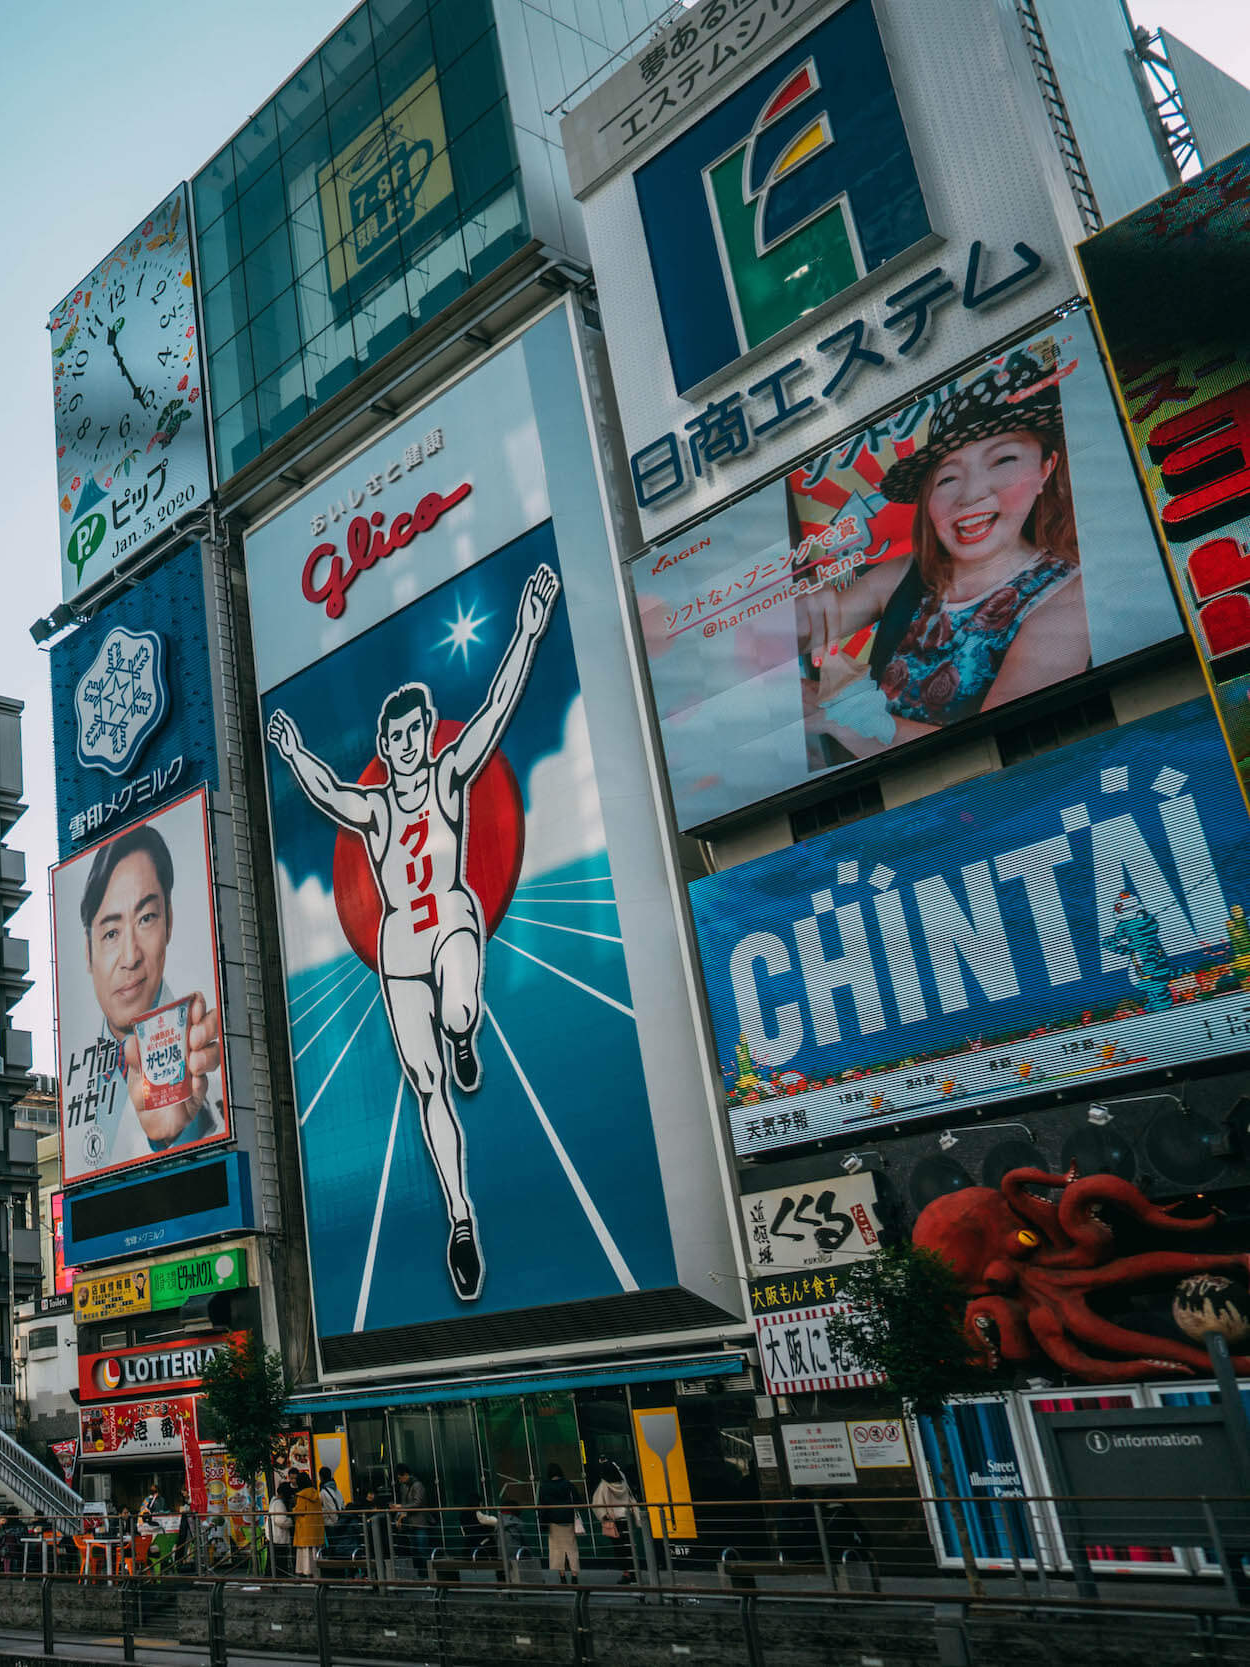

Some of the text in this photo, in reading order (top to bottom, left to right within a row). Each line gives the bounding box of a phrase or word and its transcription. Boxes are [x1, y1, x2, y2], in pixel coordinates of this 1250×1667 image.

[639, 0, 748, 84] 夢ある
[108, 284, 126, 313] 12
[136, 273, 145, 297] 1
[150, 280, 166, 305] 2
[88, 314, 104, 339] 11
[159, 306, 177, 328] 3
[72, 350, 89, 381] 10
[157, 346, 172, 367] 4
[630, 241, 1043, 508] 日商エステム
[77, 417, 91, 440] 8
[96, 426, 110, 449] 7
[119, 413, 130, 438] 6
[112, 458, 169, 529] ピップ
[310, 428, 445, 536] おいしさと健康
[112, 532, 142, 558] Jan.
[158, 484, 195, 522] 2020
[652, 537, 711, 576] KAIGEN
[665, 517, 861, 629] ソフトなハプニングで賞
[703, 552, 865, 638] @harmonica_kana
[69, 755, 184, 841] 雪印メグミルク
[399, 810, 439, 934] グリコ
[67, 1037, 119, 1086] トクホ
[68, 1081, 116, 1128] ガセリ
[744, 1110, 809, 1141] 天気予報
[770, 1190, 854, 1253] くくる
[1114, 1432, 1203, 1447] information
[970, 1472, 1021, 1487] Illuminated
[987, 1459, 1016, 1473] Street
